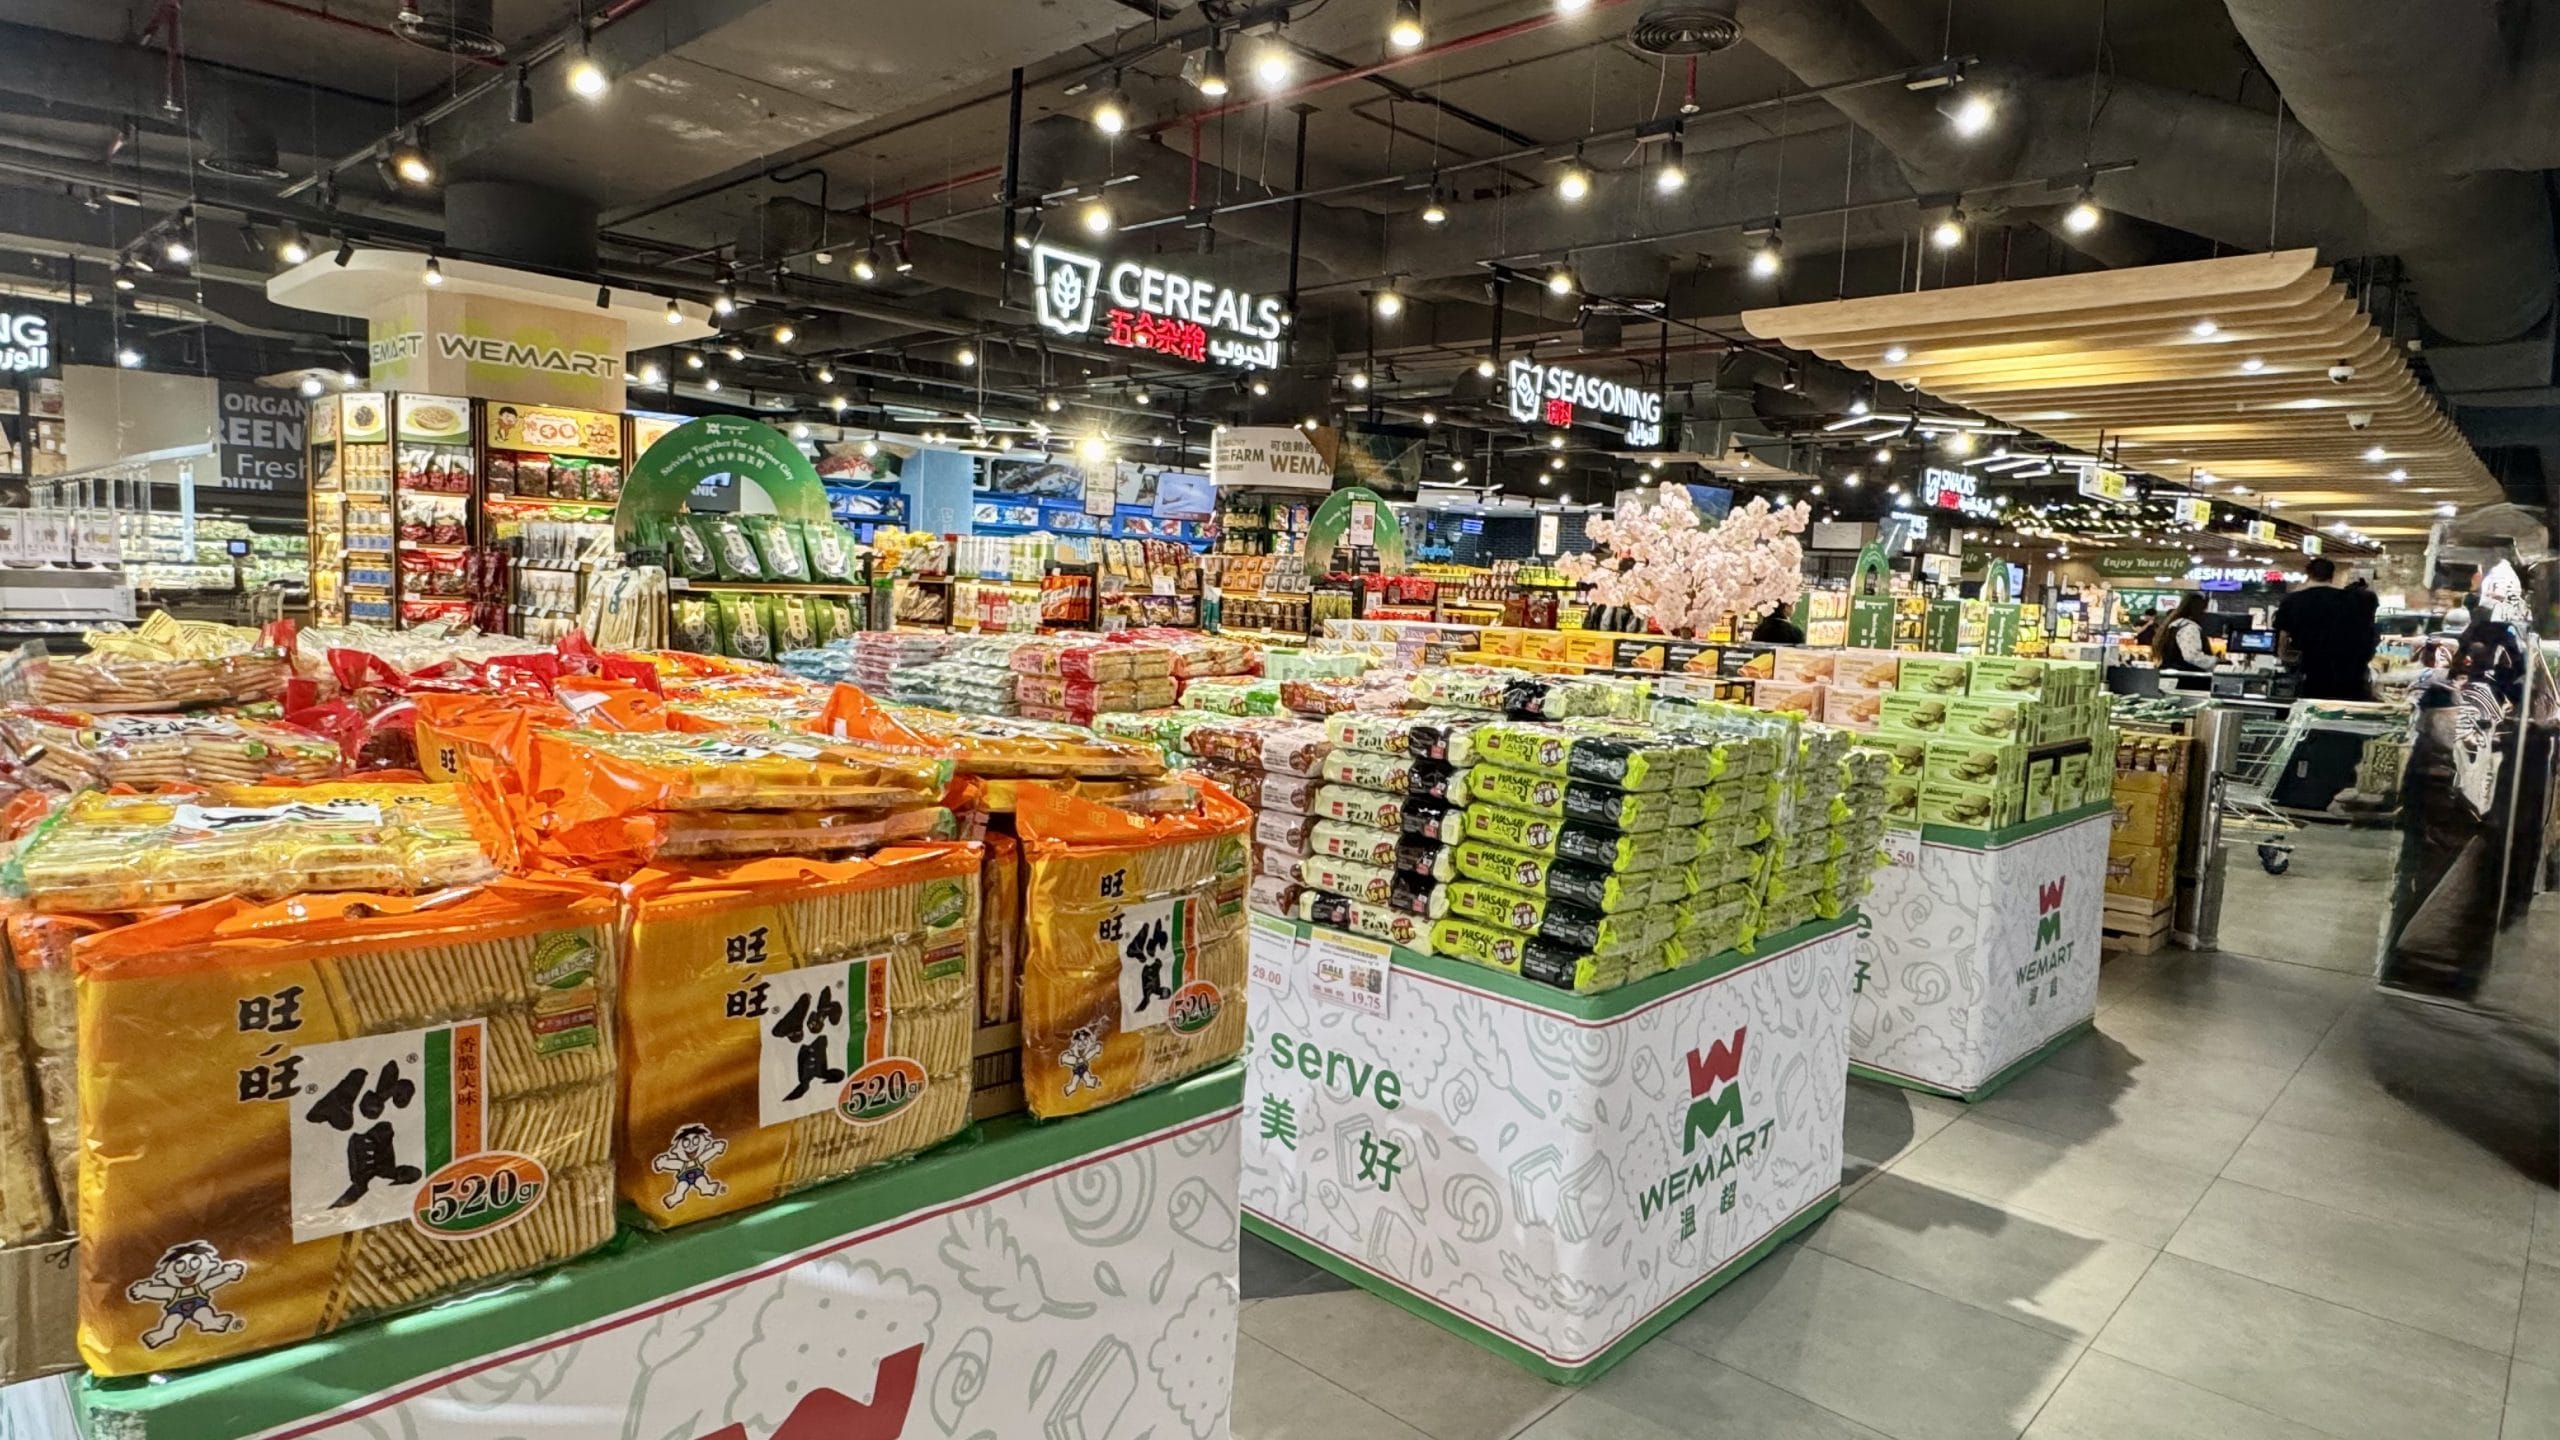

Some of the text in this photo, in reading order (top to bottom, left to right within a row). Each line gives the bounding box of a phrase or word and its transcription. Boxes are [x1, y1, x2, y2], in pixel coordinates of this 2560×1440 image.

[1110, 261, 1281, 340] CEREALS
[370, 335, 423, 366] EMART
[439, 335, 620, 377] WEMART
[1104, 308, 1207, 364] 五谷杂粮
[1209, 340, 1279, 371] الحبوب
[1546, 365, 1661, 423] SEASONING
[1230, 448, 1265, 462] FARM
[2103, 557, 2184, 568] Enjoy Your Life
[2225, 568, 2264, 582] MEAT
[1099, 869, 1126, 941] 旺旺
[725, 927, 770, 1018] 旺旺
[1252, 965, 1282, 986] 29.00
[2016, 940, 2075, 986] WEMART
[1352, 991, 1381, 1009] 19.75
[237, 985, 304, 1102] 旺旺
[847, 1067, 924, 1112] 520g
[1271, 1032, 1401, 1110] serve
[1639, 1119, 1775, 1222] WEMART
[430, 1169, 534, 1223] 520g
